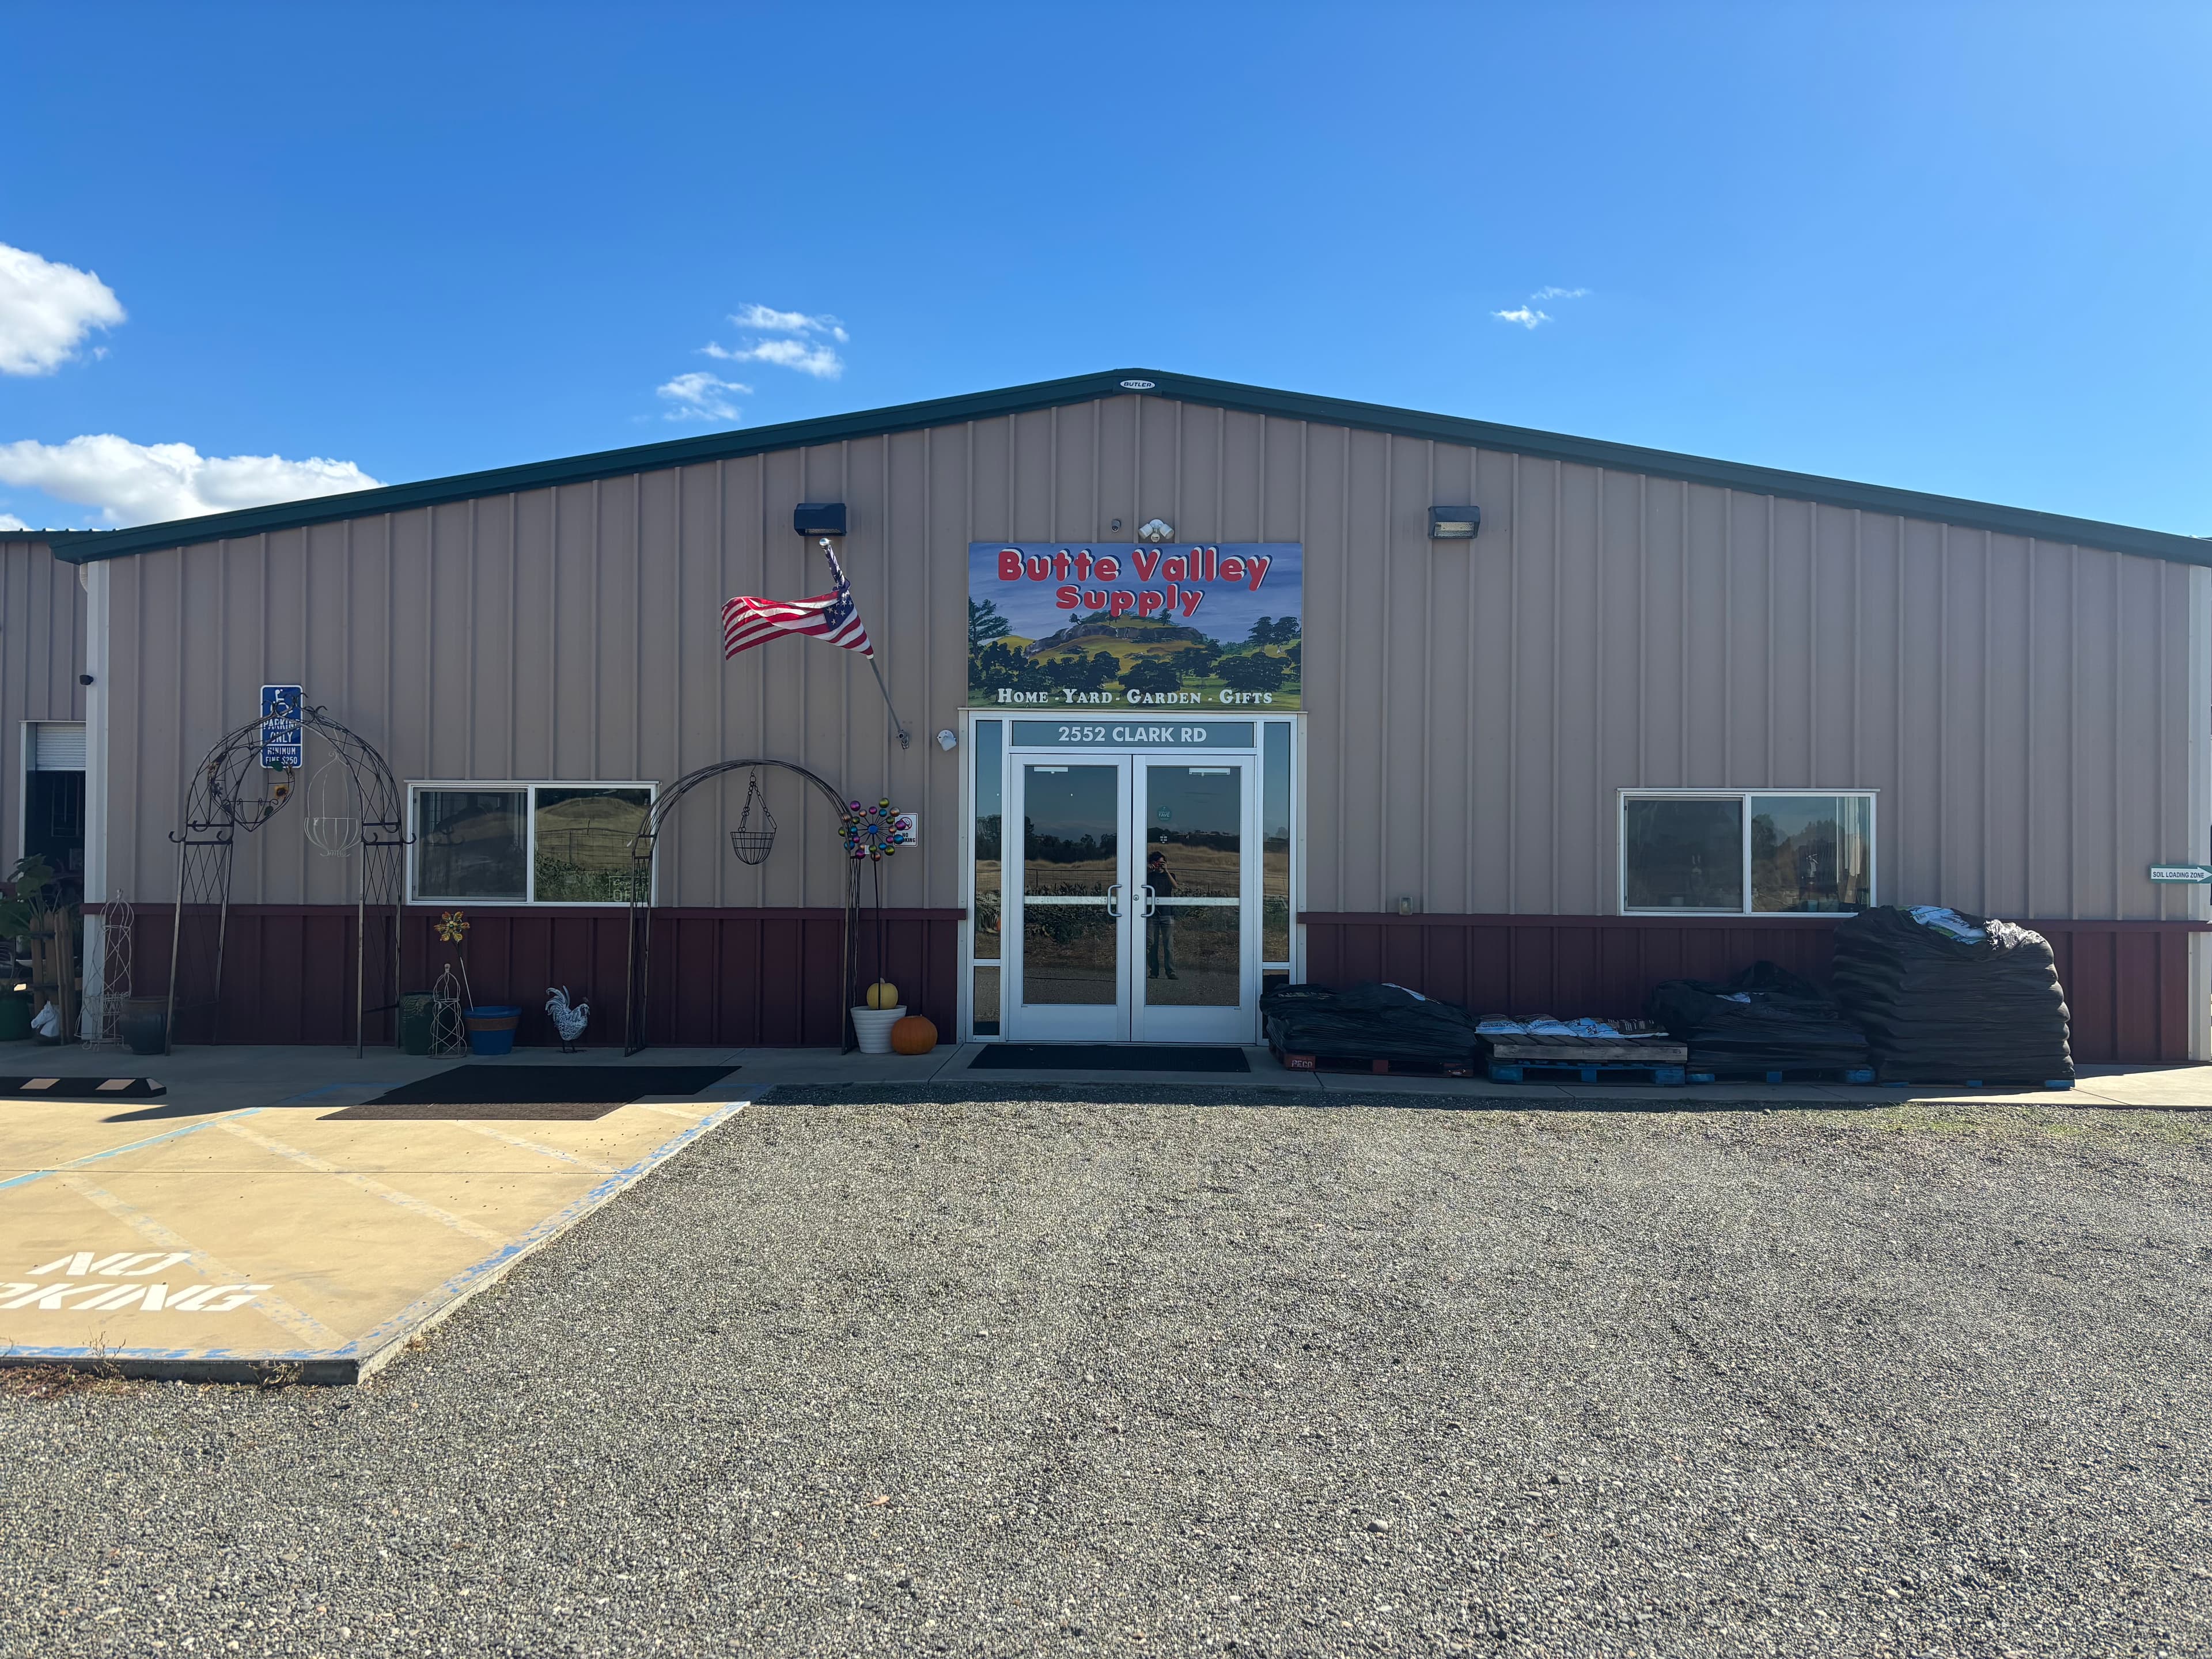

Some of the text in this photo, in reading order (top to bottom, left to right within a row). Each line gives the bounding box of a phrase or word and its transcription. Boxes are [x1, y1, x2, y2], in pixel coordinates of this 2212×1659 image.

[998, 546, 1272, 592] Butte Valley
[1056, 582, 1205, 618] Supply
[270, 732, 293, 743] ONLY
[1059, 726, 1207, 742] 2552 CLARK RD
[24, 1252, 192, 1276] NO
